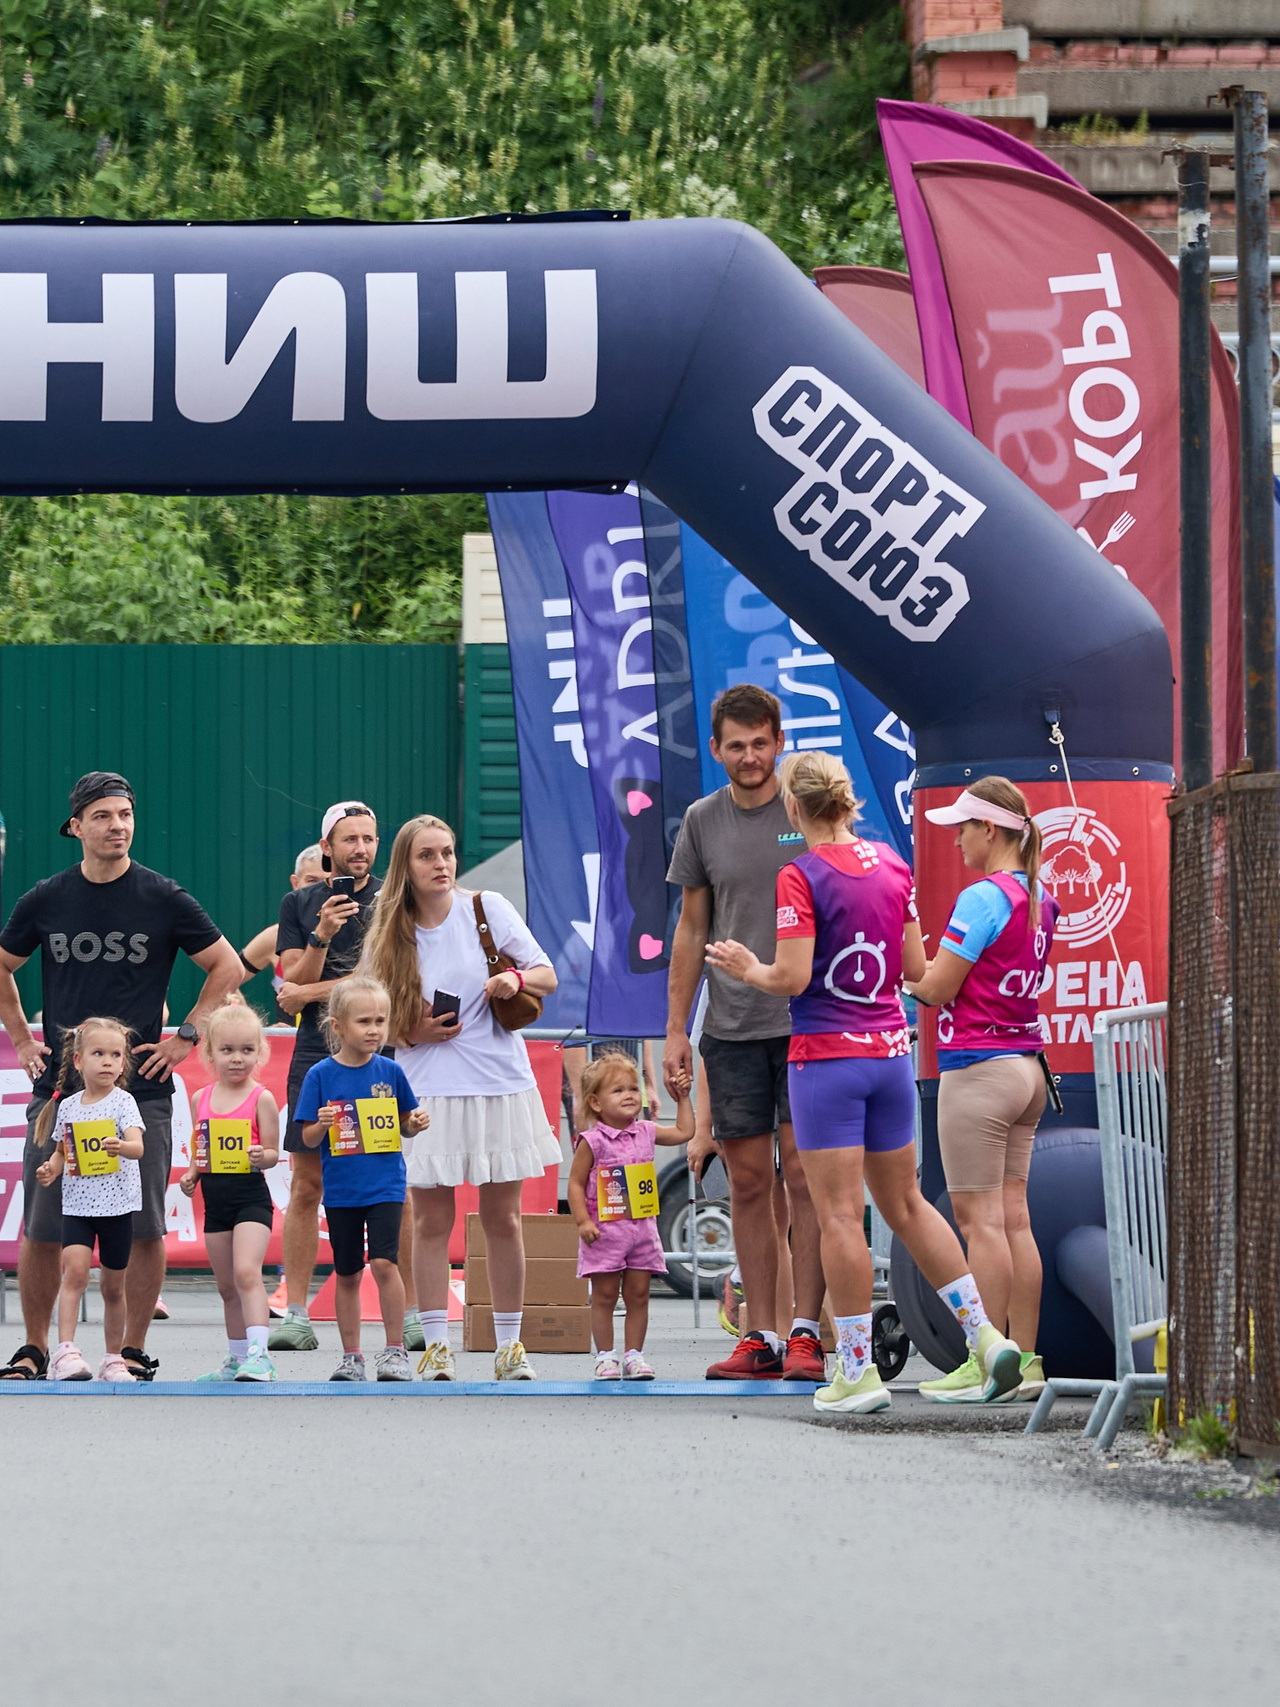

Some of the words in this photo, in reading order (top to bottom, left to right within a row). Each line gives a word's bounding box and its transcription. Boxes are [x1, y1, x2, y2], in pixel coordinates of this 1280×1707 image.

[768, 379, 966, 547] СПОРТ
[787, 482, 954, 628] СОЮЗ
[49, 931, 150, 964] BOSS
[1038, 960, 1148, 1007] РЕНА
[367, 1115, 395, 1130] 103
[218, 1136, 243, 1151] 101
[638, 1179, 654, 1195] 98
